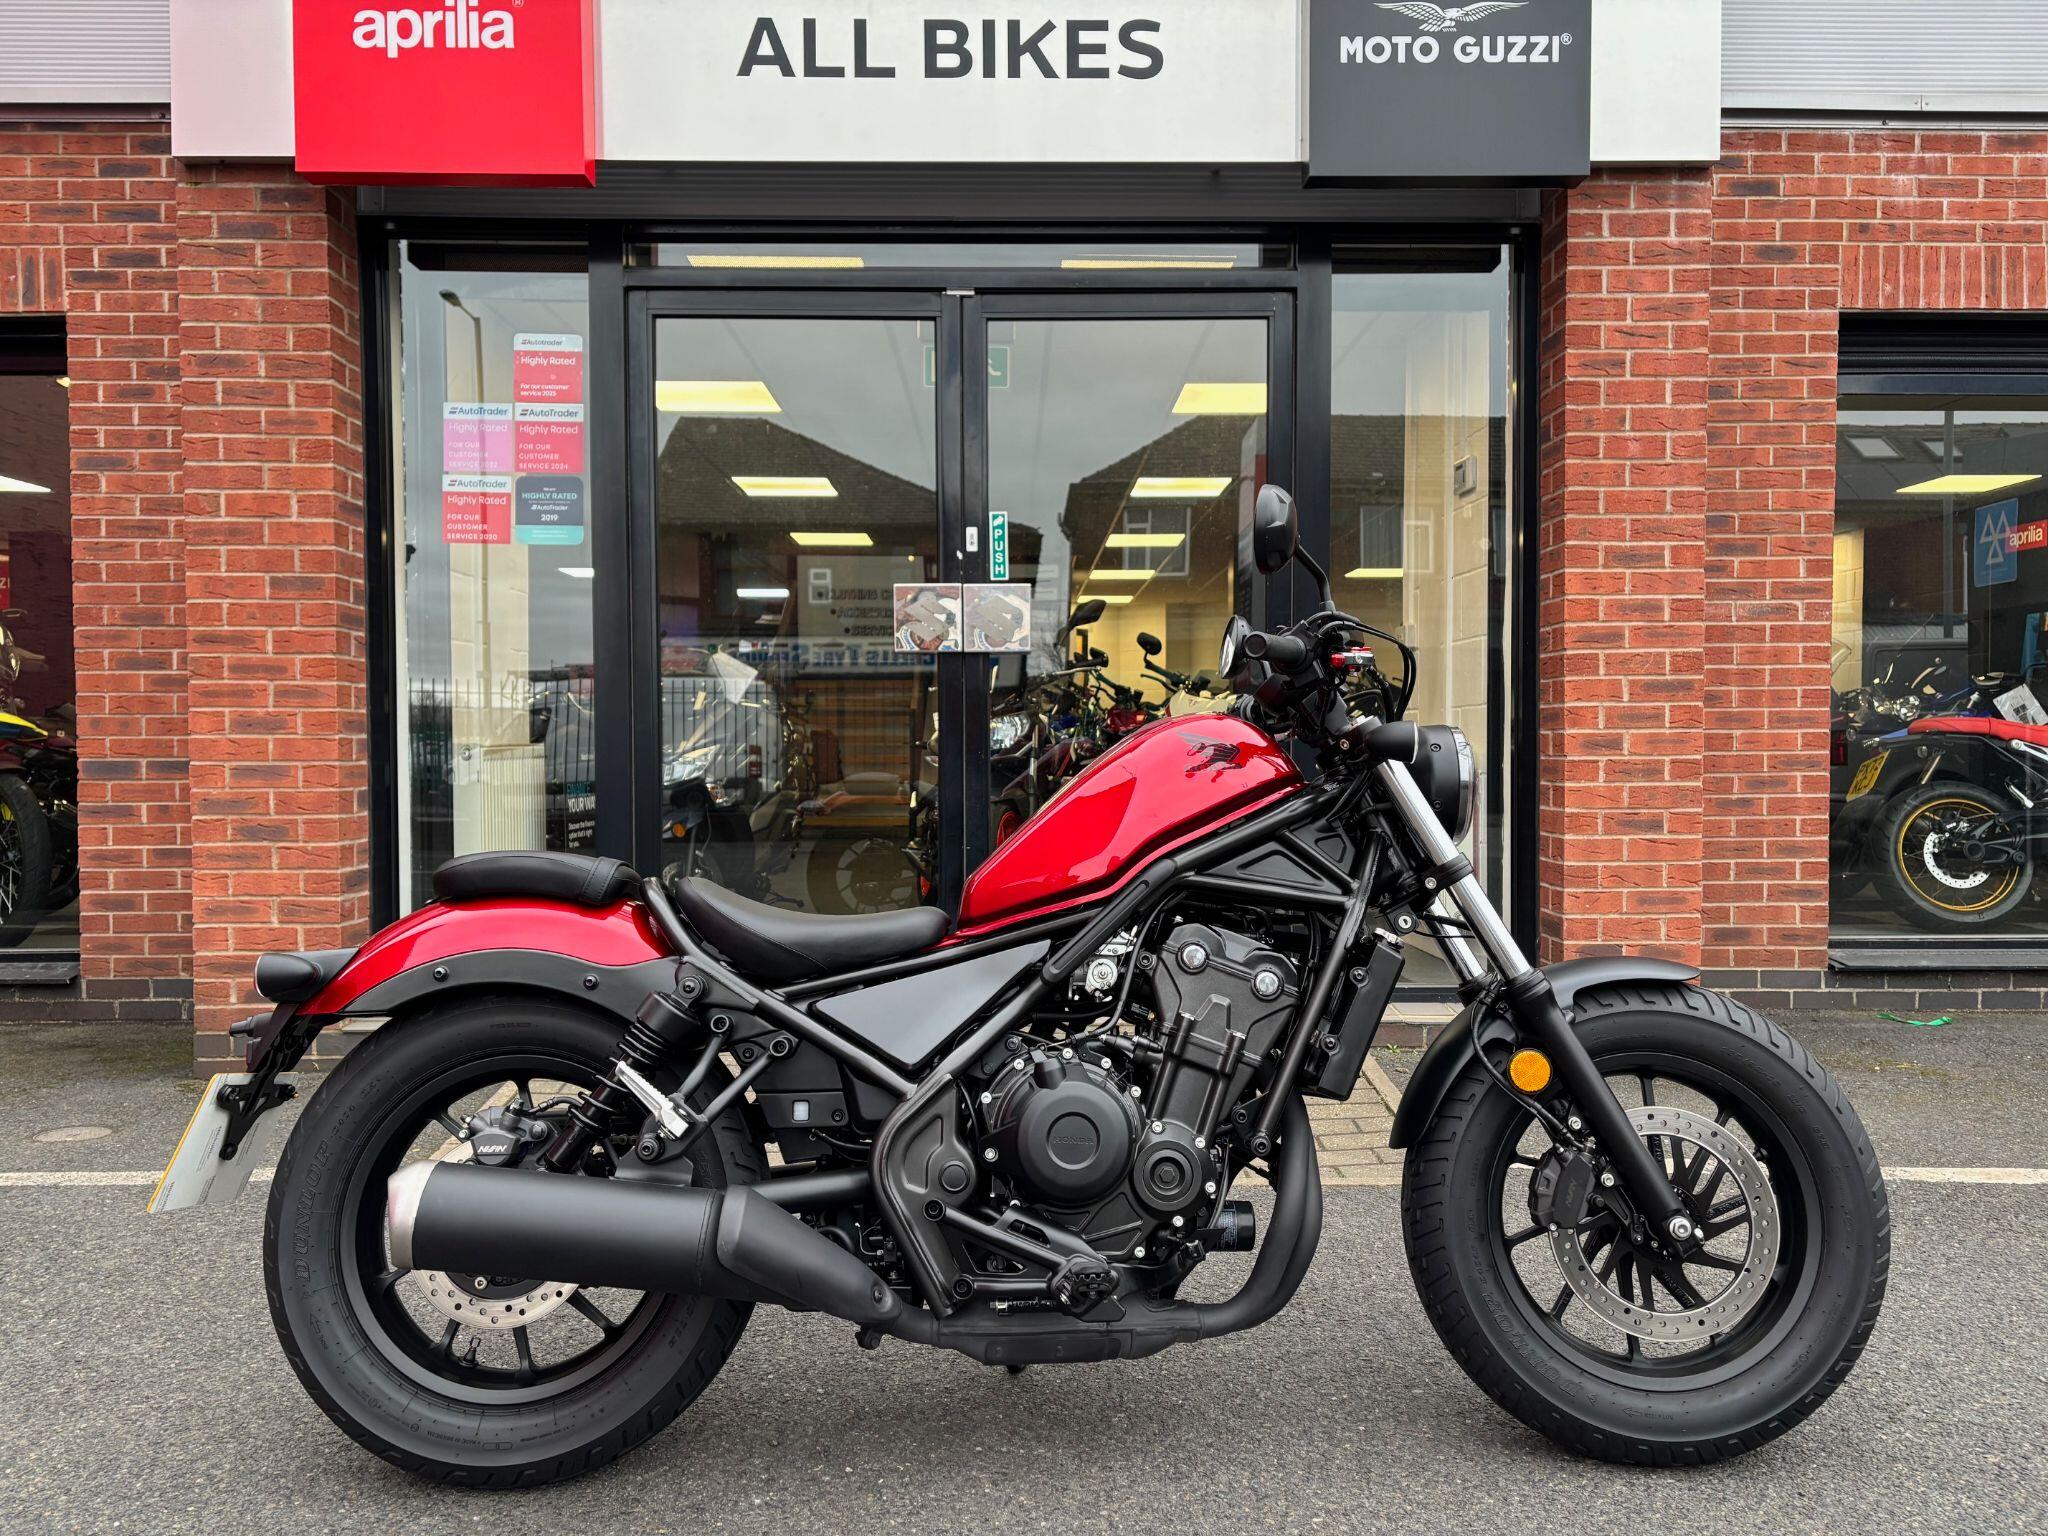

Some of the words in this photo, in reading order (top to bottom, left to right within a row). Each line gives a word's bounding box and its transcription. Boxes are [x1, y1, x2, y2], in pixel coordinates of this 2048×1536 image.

[735, 17, 896, 79] ALL
[923, 18, 1164, 80] BIKES
[1340, 35, 1440, 64] MOTO
[520, 356, 548, 366] Highly
[549, 356, 576, 365] Rated
[458, 406, 508, 416] AutoTrader
[529, 408, 579, 418] AutoTrader
[449, 423, 478, 433] Highly
[480, 423, 508, 432] Rated
[520, 425, 548, 435] Highly
[550, 425, 578, 434] Rated
[457, 479, 507, 488] AutoTrader
[447, 495, 476, 506] Highly
[478, 496, 507, 505] Rated
[521, 492, 552, 500] HIGHLY
[552, 492, 577, 500] RATED
[2009, 524, 2043, 548] aprilia
[994, 530, 1004, 575] PUSH
[567, 797, 585, 813] YOUR
[1053, 1135, 1095, 1145] HONDA
[293, 1138, 331, 1282] DUNLOP
